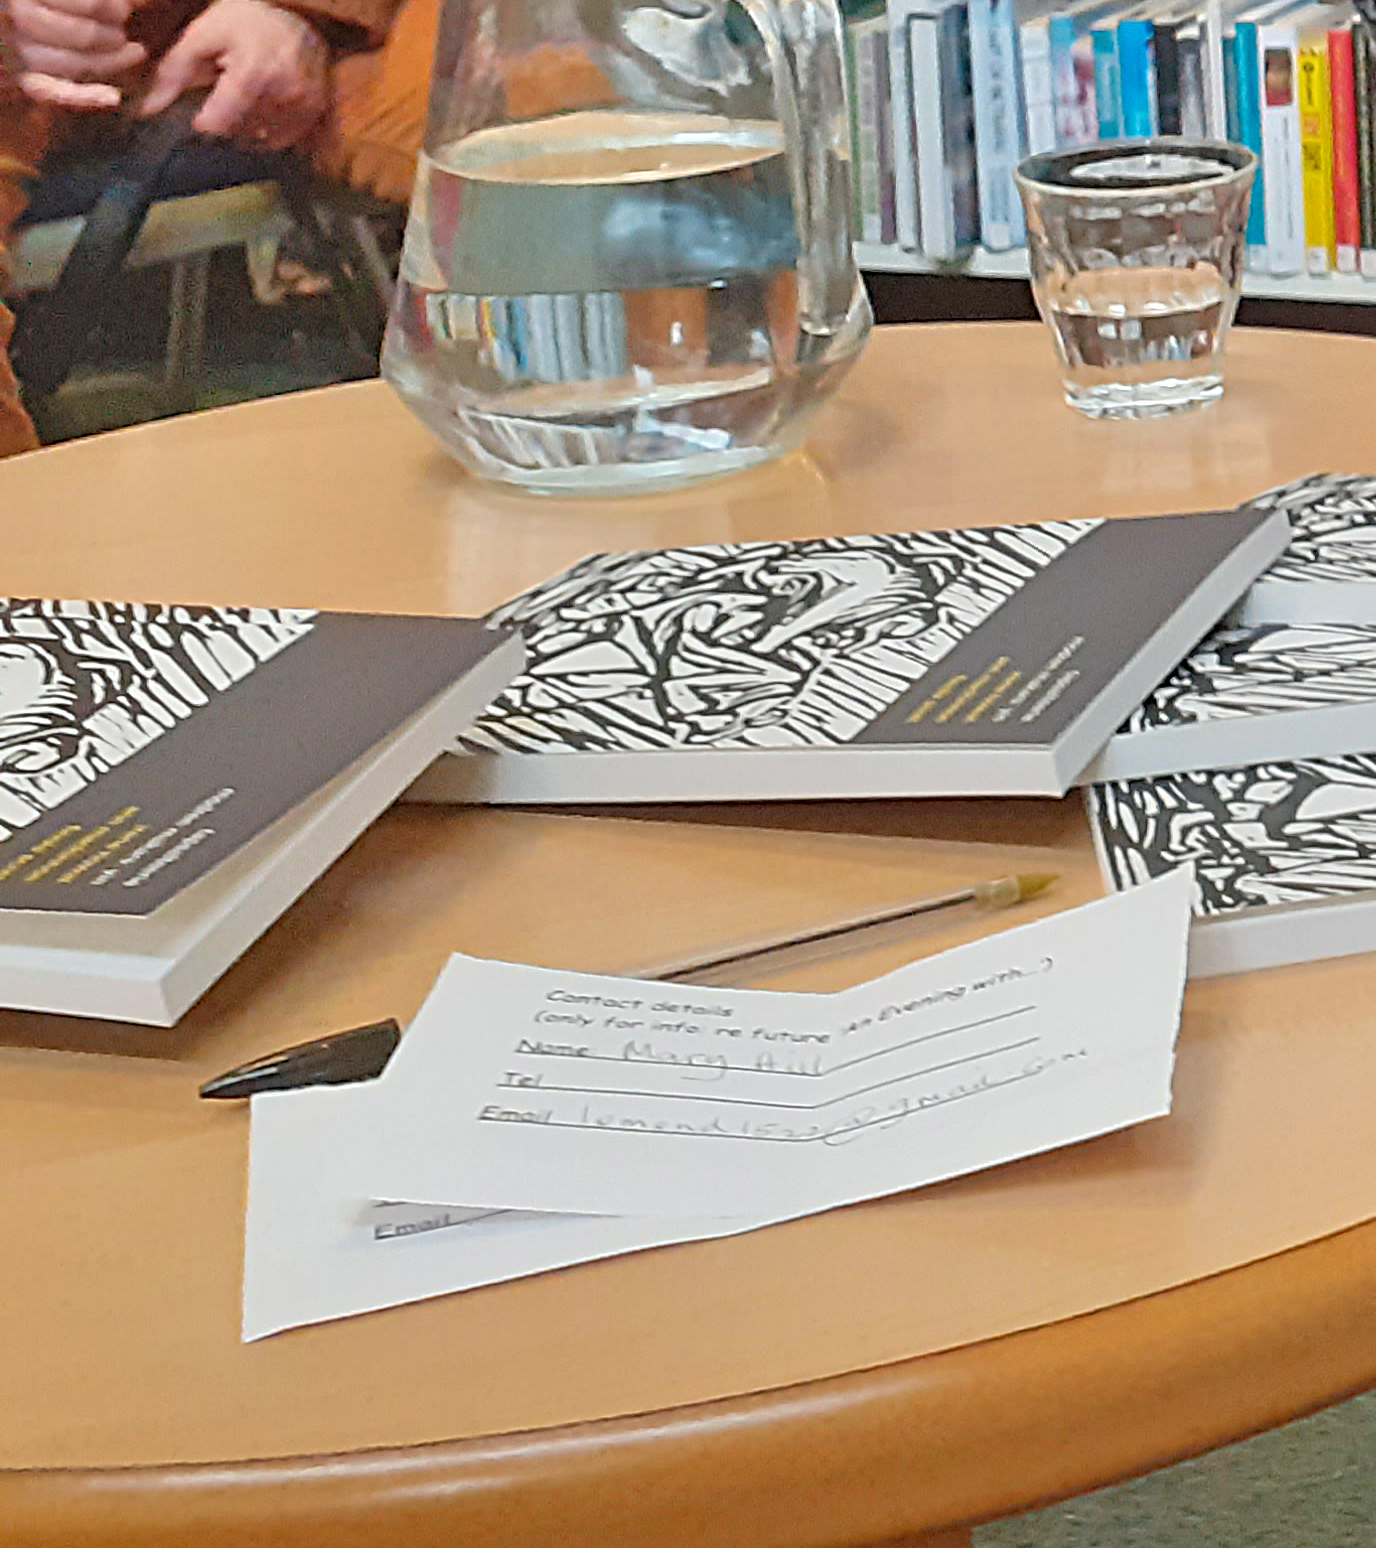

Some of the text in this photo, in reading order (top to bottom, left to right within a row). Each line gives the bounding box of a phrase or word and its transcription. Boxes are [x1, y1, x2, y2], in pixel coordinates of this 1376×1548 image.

[534, 1009, 595, 1028] (only
[605, 1015, 645, 1030] for
[715, 1026, 742, 1038] re
[750, 1027, 831, 1045] future
[876, 985, 967, 1022] Evening
[545, 989, 736, 1019] Contact details
[515, 1038, 592, 1058] Name
[622, 1040, 729, 1082] Mary
[502, 1070, 544, 1088] Tel
[478, 1104, 554, 1125] Email
[373, 1213, 454, 1242] Email
